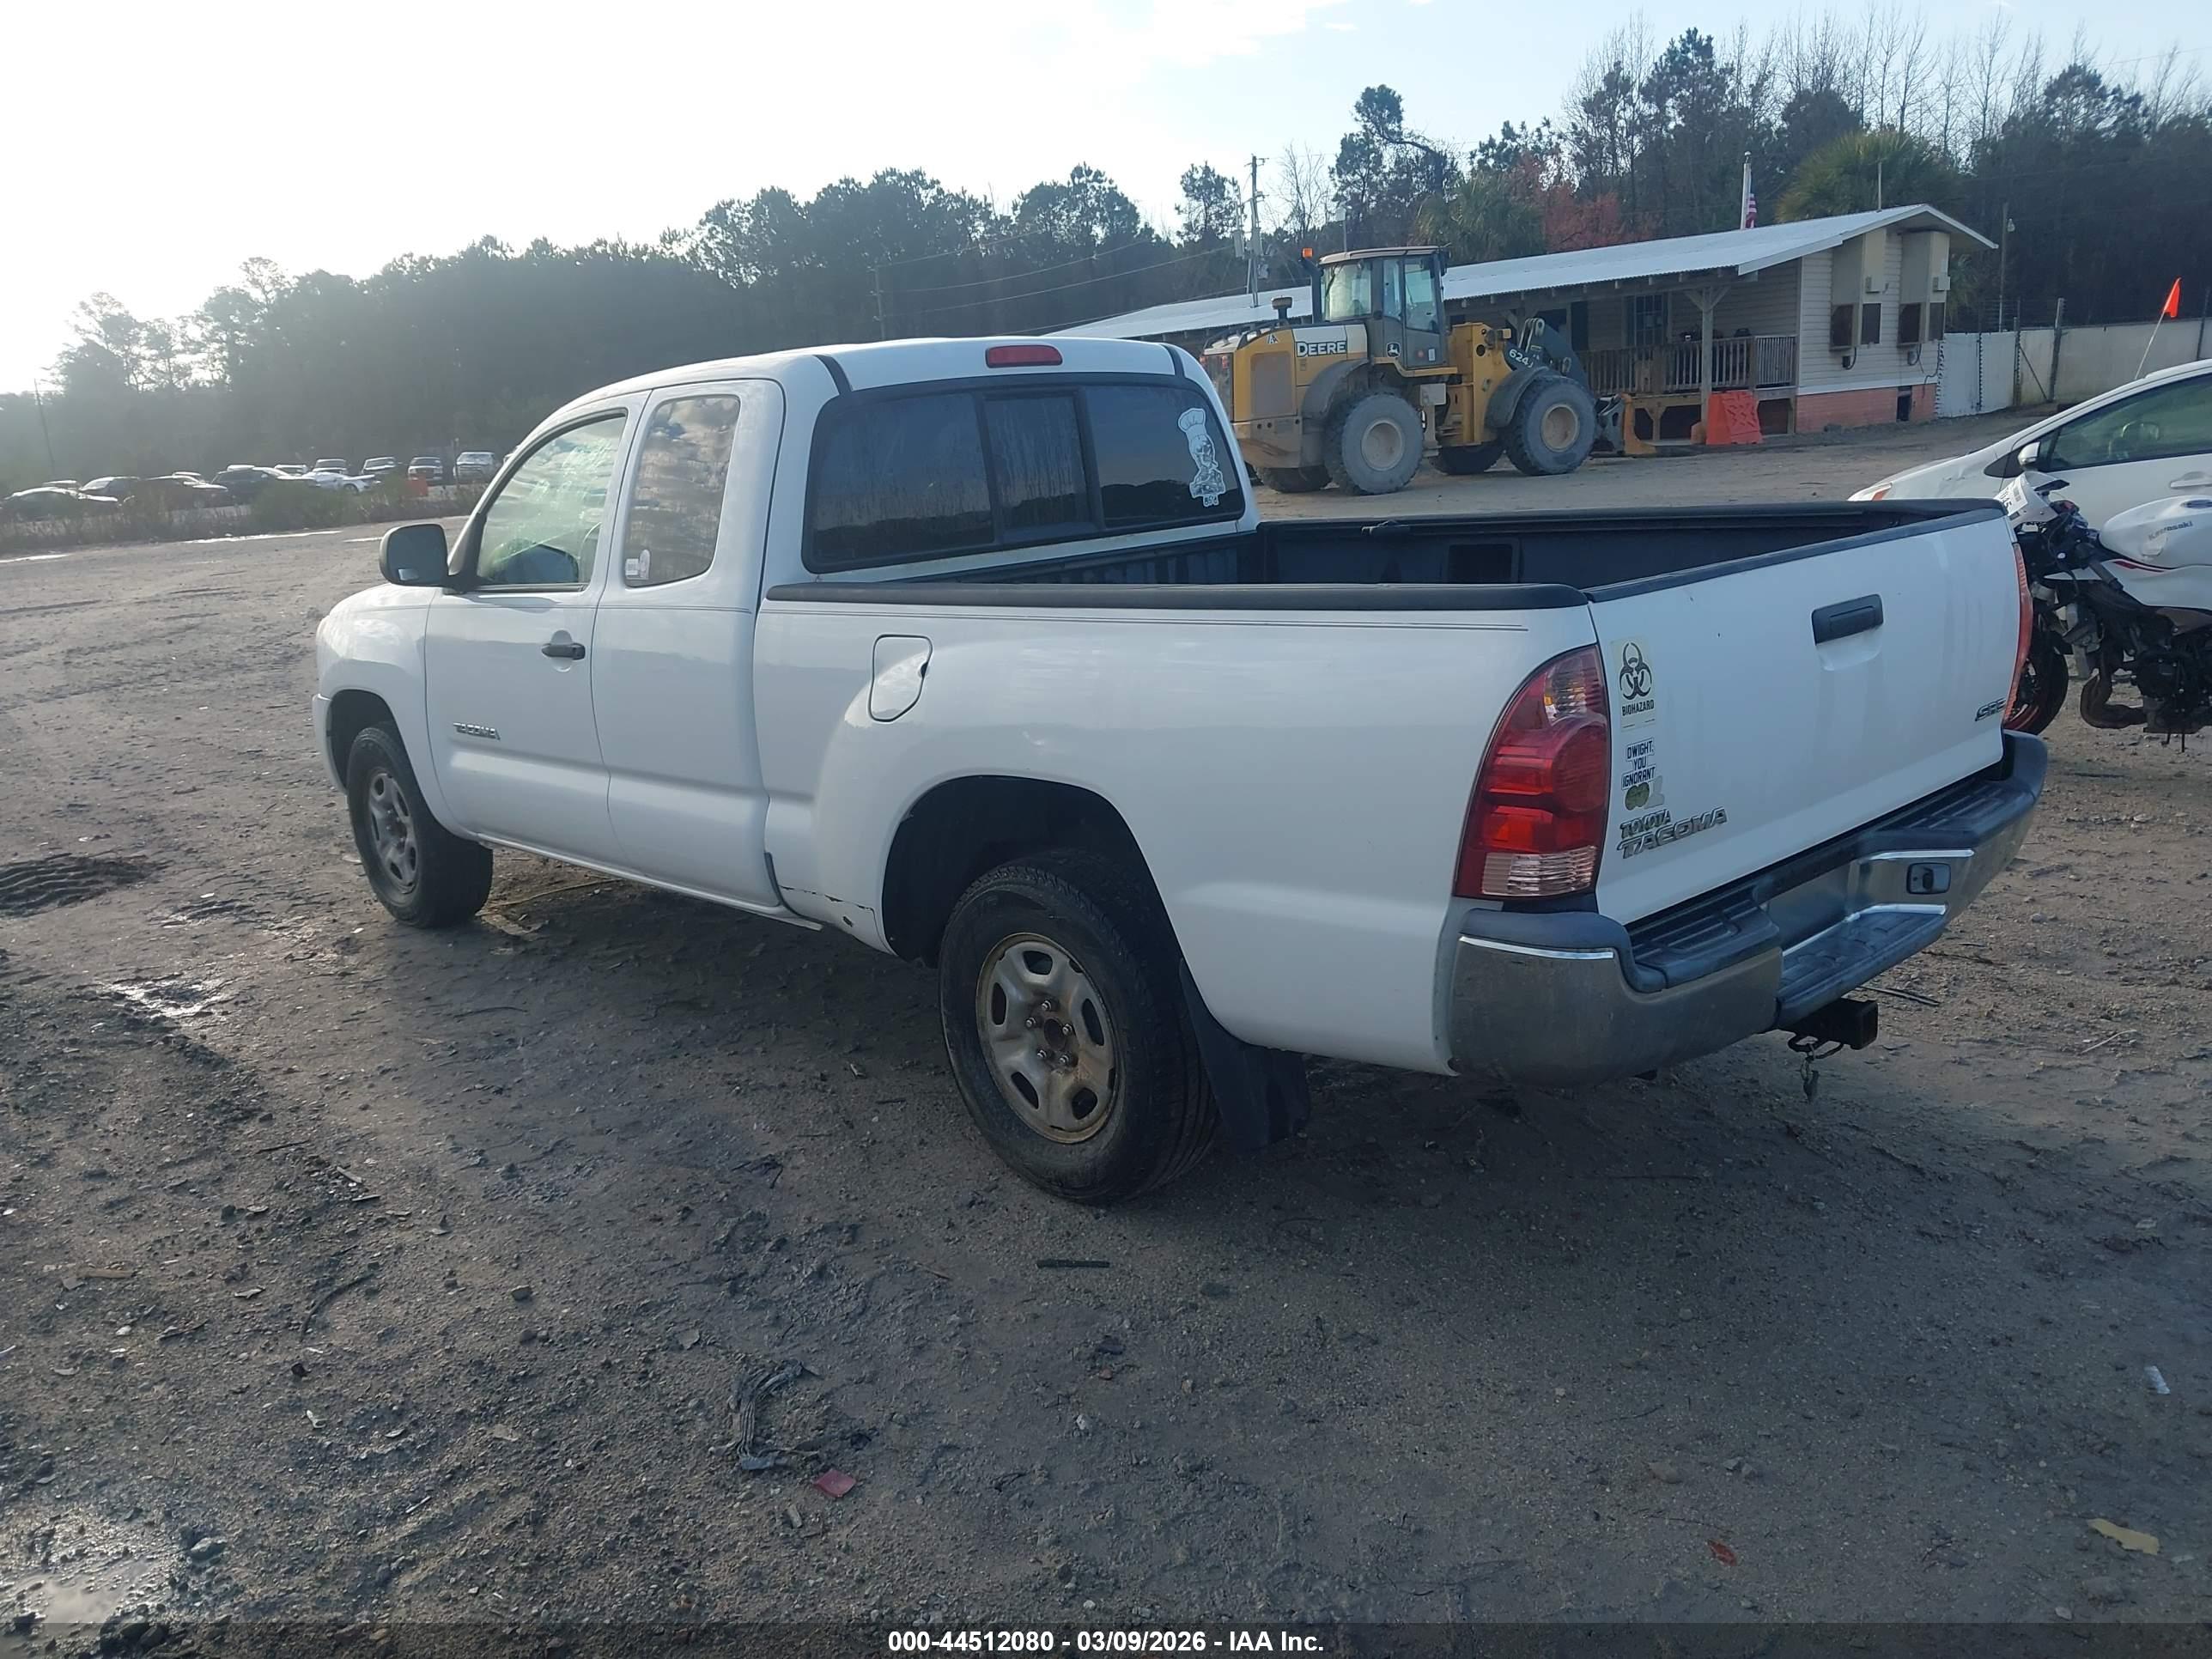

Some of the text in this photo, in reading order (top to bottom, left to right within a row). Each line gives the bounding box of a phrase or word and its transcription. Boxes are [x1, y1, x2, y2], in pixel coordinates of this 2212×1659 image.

[1296, 341, 1346, 357] DEERE
[2148, 520, 2193, 541] Kawasaki
[1621, 699, 1655, 717] BIOHAZARD
[1633, 756, 1647, 771] YOU
[1622, 766, 1656, 788] IGNORANT
[1616, 806, 1728, 860] TACOMA
[1620, 809, 1671, 840] TOYOTA
